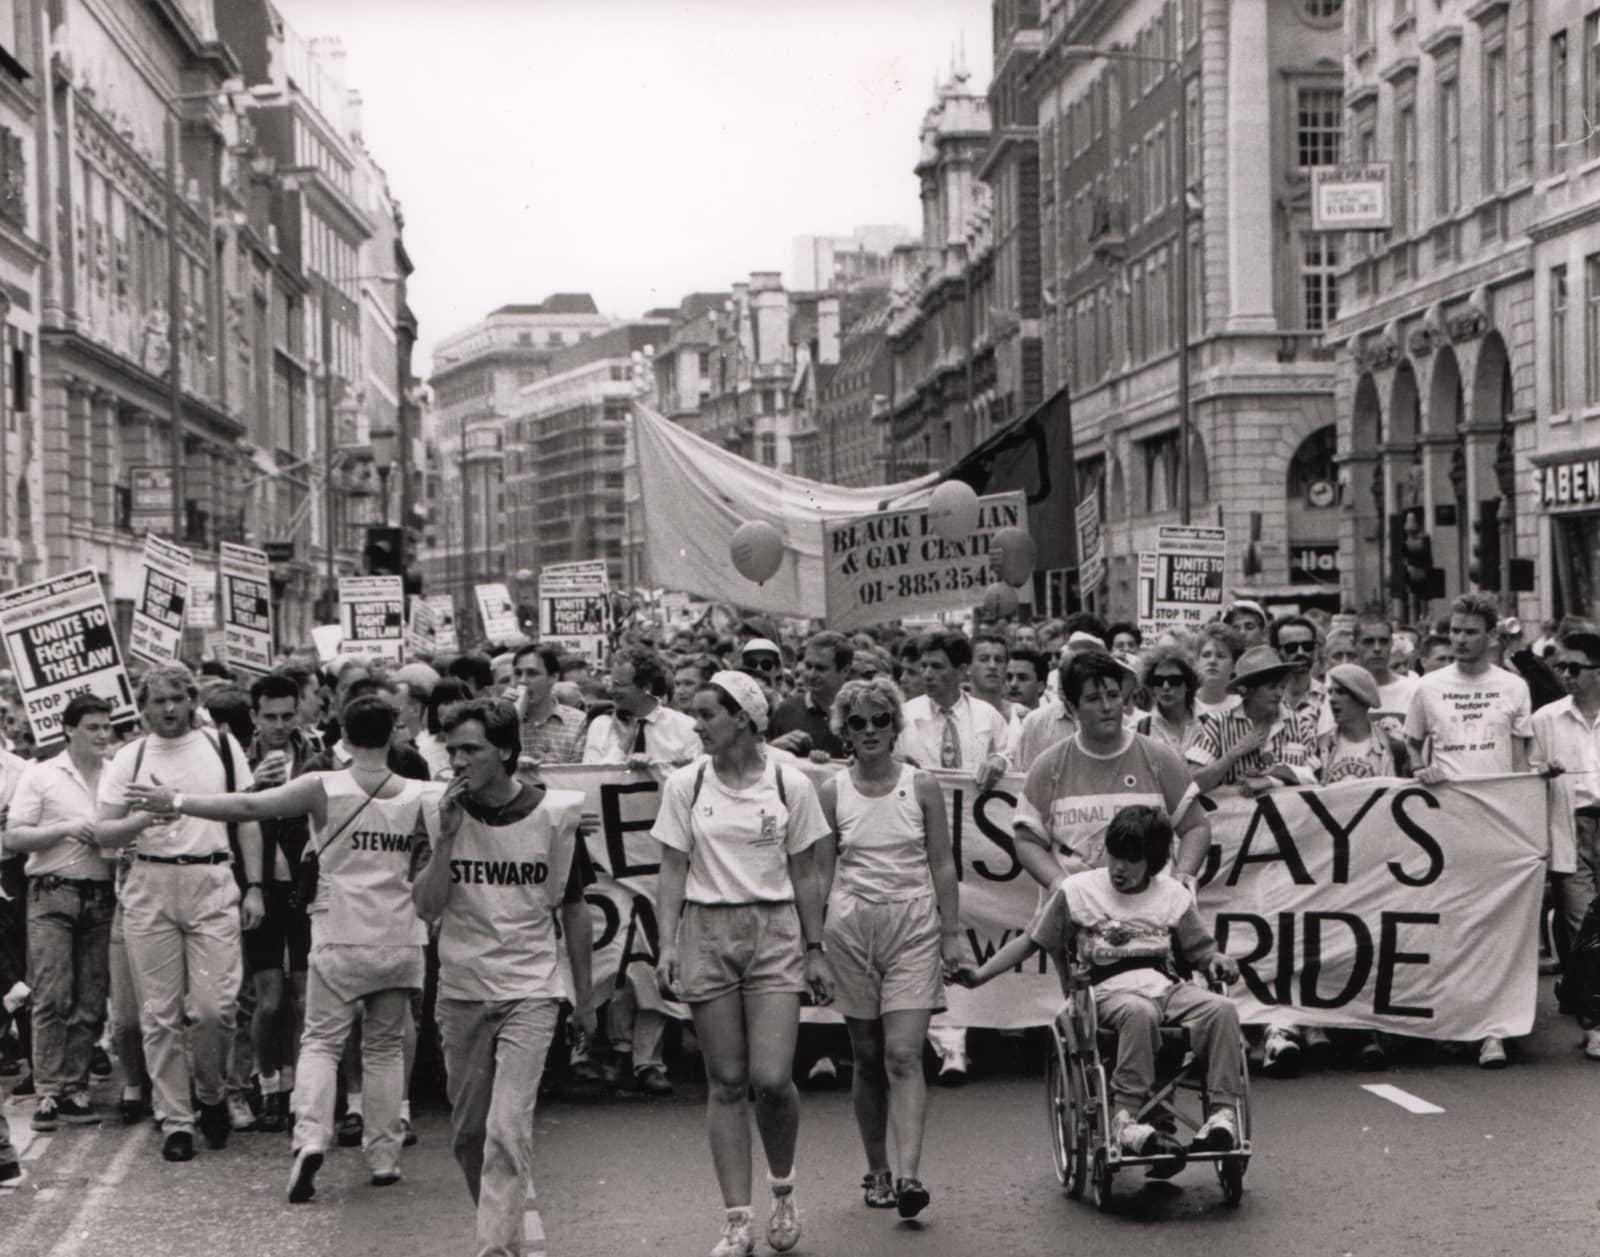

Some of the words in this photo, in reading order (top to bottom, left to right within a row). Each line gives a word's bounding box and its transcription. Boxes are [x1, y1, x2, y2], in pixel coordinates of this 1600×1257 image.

[1531, 460, 1600, 504] SABEN
[832, 515, 910, 552] BLACK
[920, 504, 1018, 536] LIAN
[842, 552, 859, 575] &
[866, 541, 911, 569] GAY
[921, 533, 993, 561] CENT
[1173, 556, 1208, 571] UNITE
[1211, 559, 1224, 572] TO
[1172, 572, 1208, 587] FIGHT
[28, 614, 84, 646] UNITE
[83, 608, 106, 629] TO
[1155, 608, 1180, 620] STOP
[1183, 608, 1200, 620] THE
[34, 633, 85, 665] FIGHT
[28, 693, 61, 714] STOP
[450, 860, 549, 886] STEWARD
[1214, 911, 1441, 1019] RIDE
